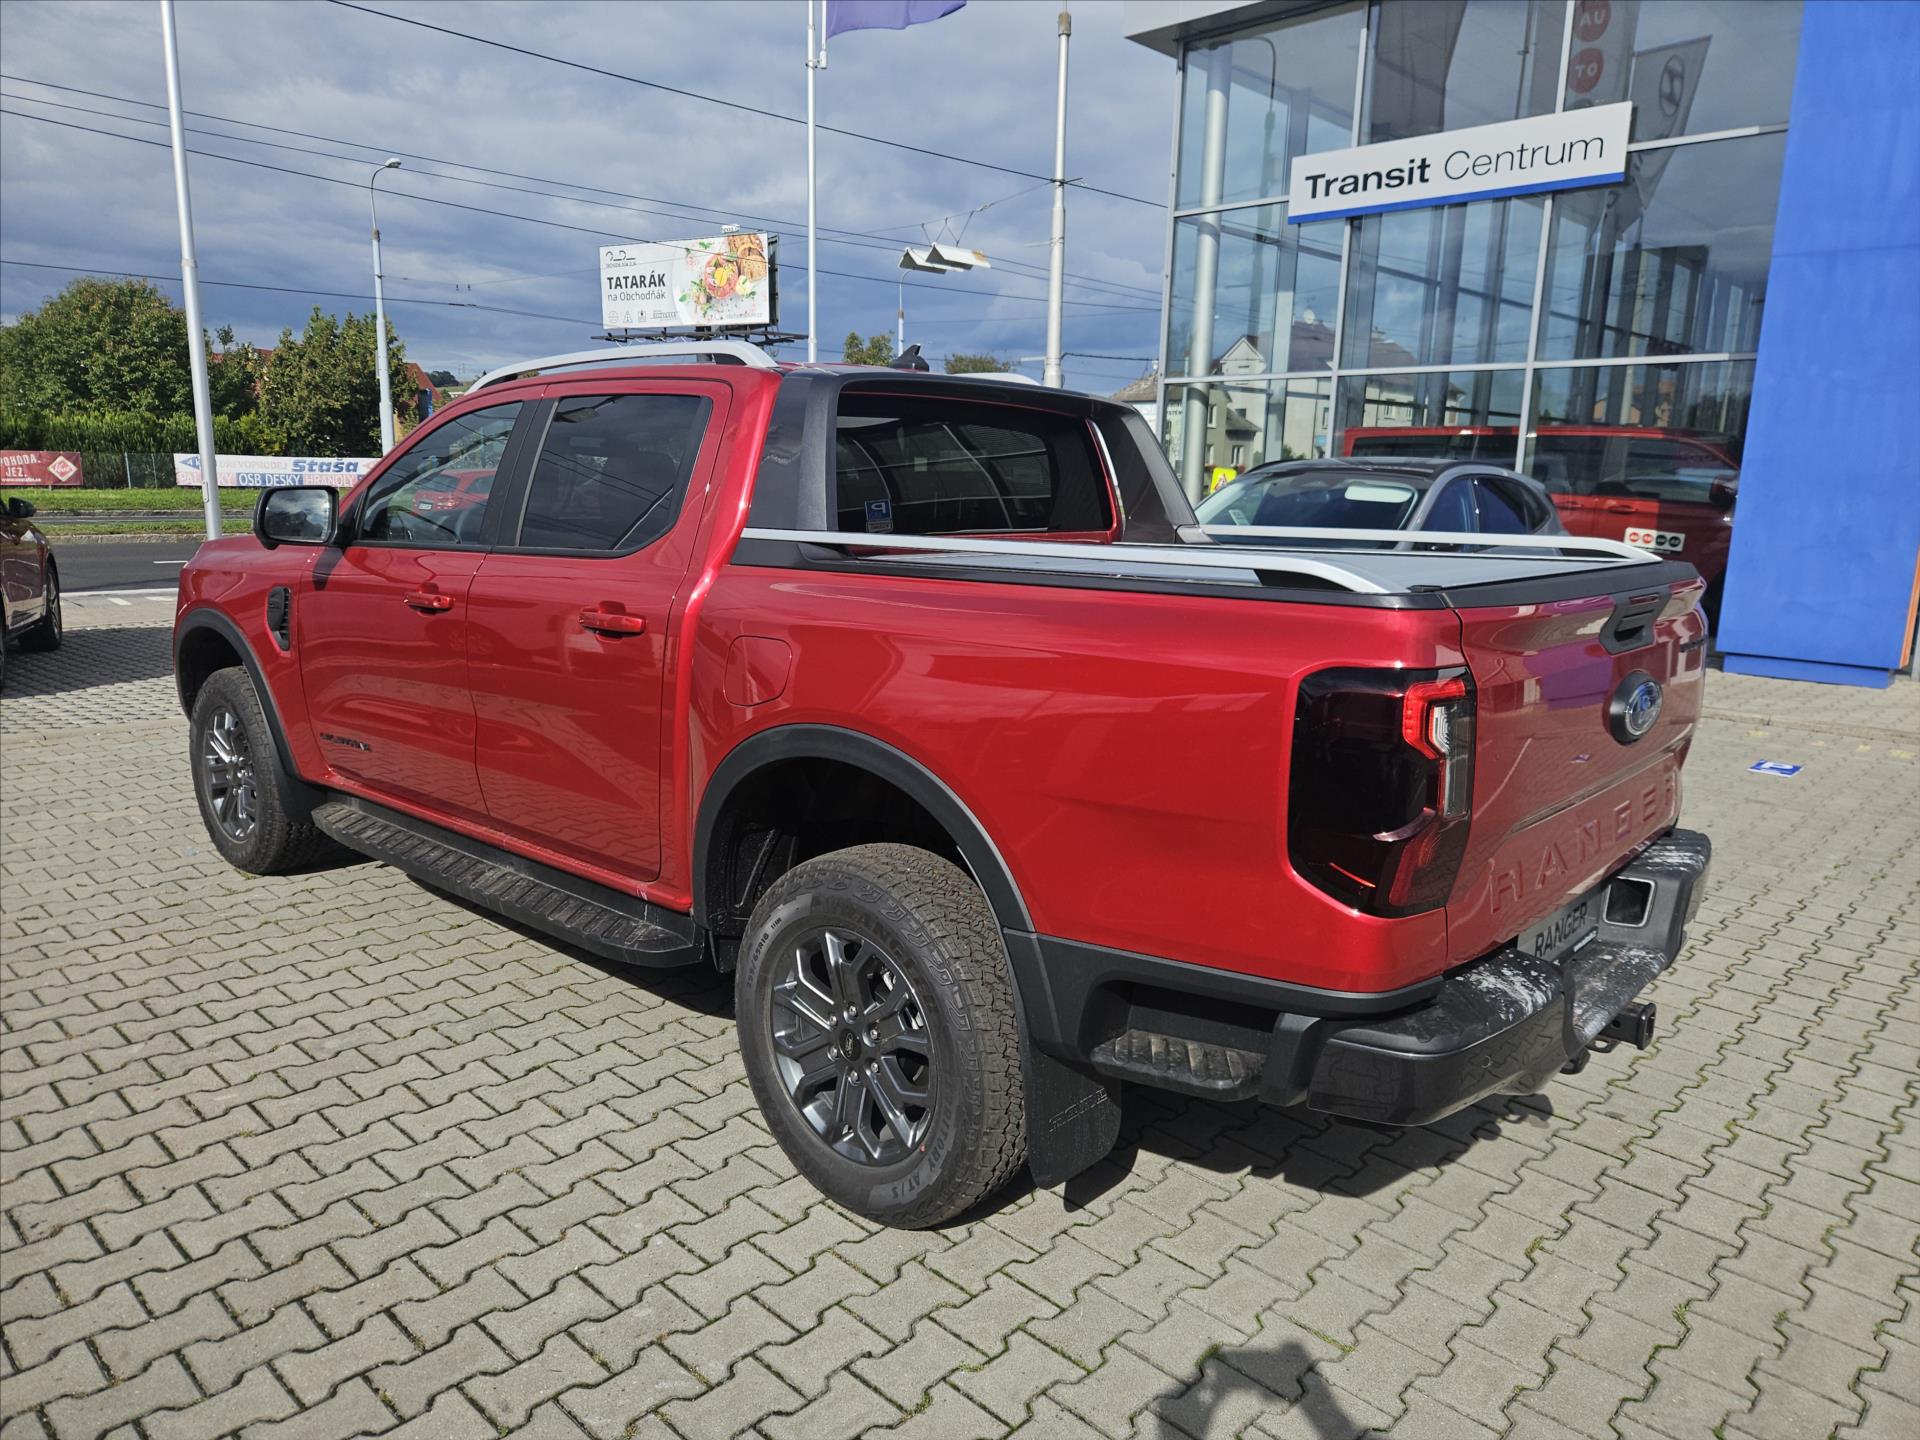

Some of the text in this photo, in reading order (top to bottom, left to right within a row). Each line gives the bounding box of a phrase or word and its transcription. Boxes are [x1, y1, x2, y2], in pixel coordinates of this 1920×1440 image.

[1304, 136, 1605, 200] Transit Centrum
[606, 270, 666, 290] TATARÁK
[608, 293, 618, 301] na
[5, 466, 27, 477] JEZ.
[291, 458, 359, 473] Staša
[238, 473, 262, 486] OSB
[265, 474, 300, 487] DESKY
[1534, 901, 1588, 958] RANGER
